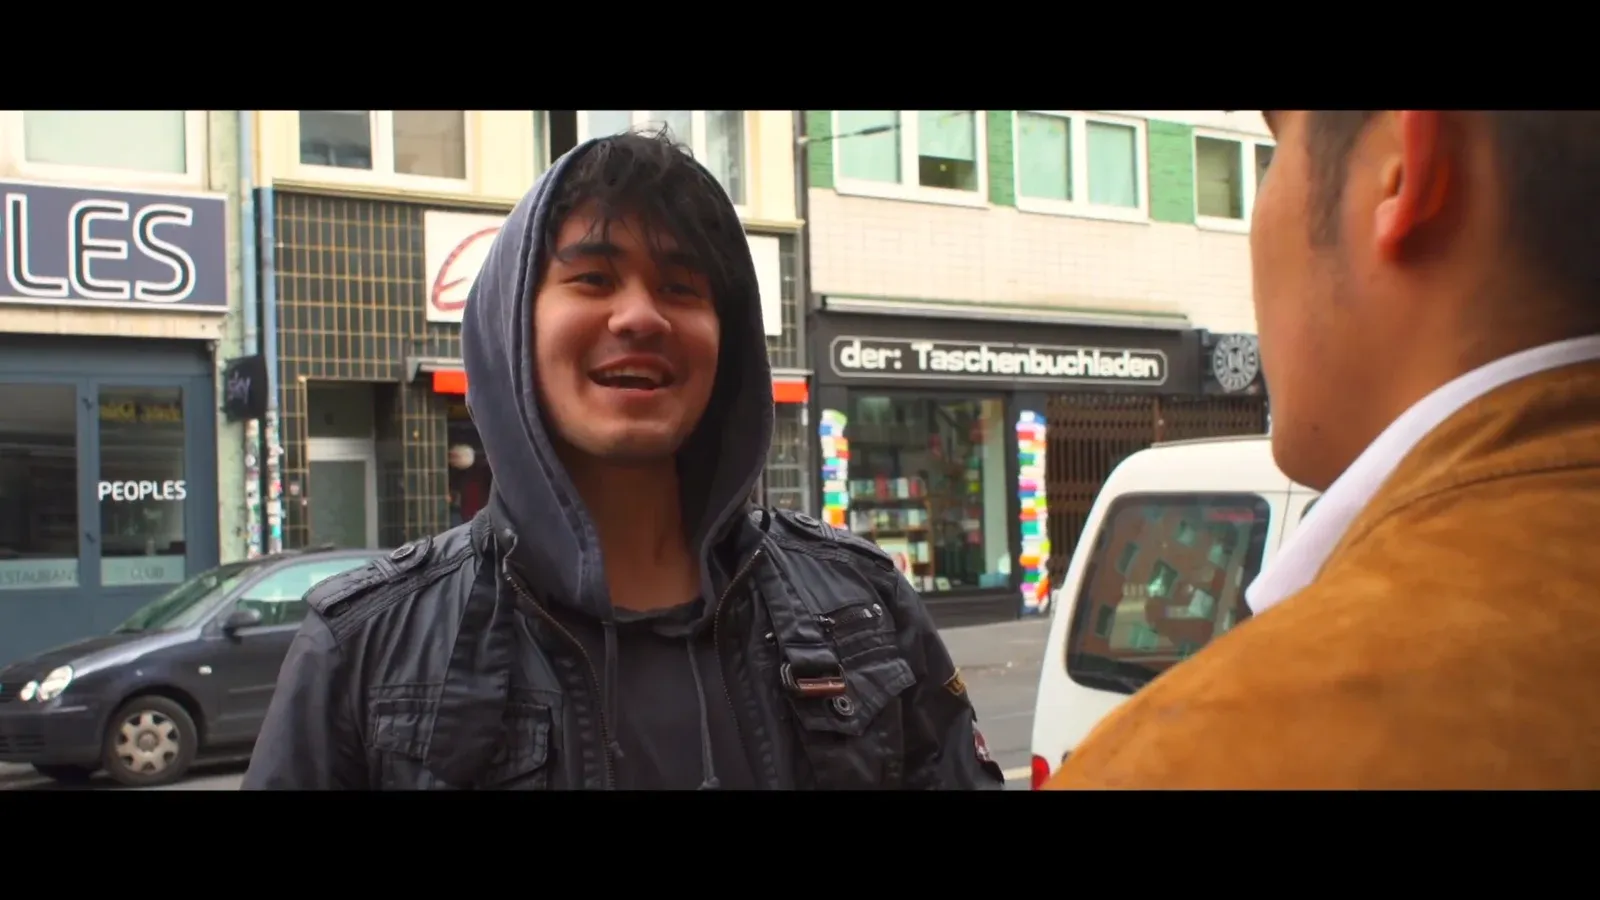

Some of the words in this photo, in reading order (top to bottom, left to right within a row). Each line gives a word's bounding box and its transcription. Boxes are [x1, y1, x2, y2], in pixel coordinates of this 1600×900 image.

[839, 338, 902, 370] der:
[910, 340, 1160, 378] Taschenbuchladen
[97, 479, 187, 501] PEOPLES
